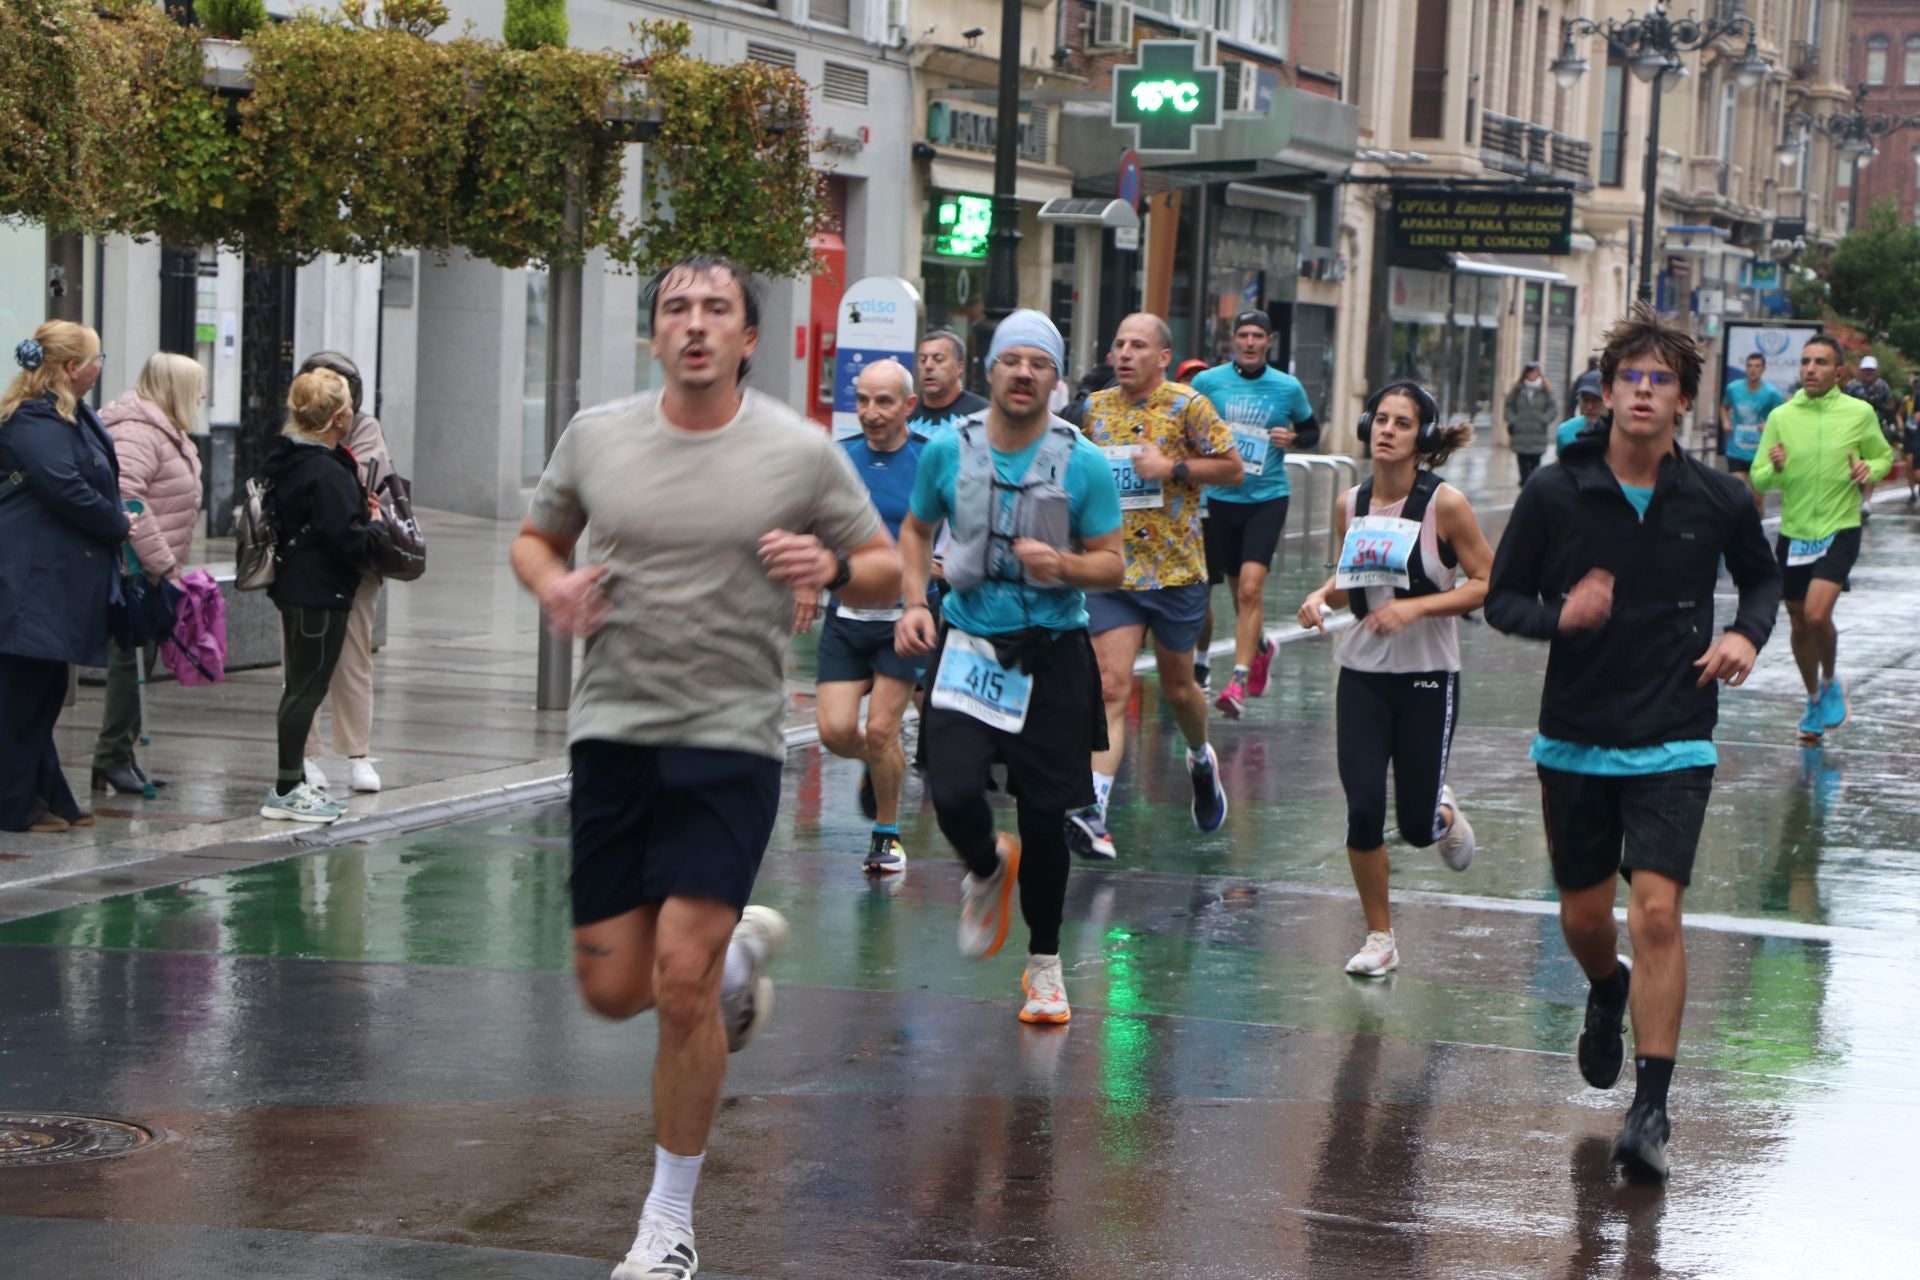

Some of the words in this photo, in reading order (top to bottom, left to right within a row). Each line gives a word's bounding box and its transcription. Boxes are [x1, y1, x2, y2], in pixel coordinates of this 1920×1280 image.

[1399, 217, 1467, 231] APARATOS
[1469, 219, 1505, 232] PARA
[1508, 220, 1563, 233] SORDOS
[1409, 233, 1457, 247] LENTES
[1460, 234, 1480, 247] DE
[1483, 235, 1550, 249] CONTACTO
[860, 298, 896, 313] alsa
[1351, 538, 1394, 566] 347
[964, 664, 1006, 702] 415
[1413, 680, 1440, 689] FILA
